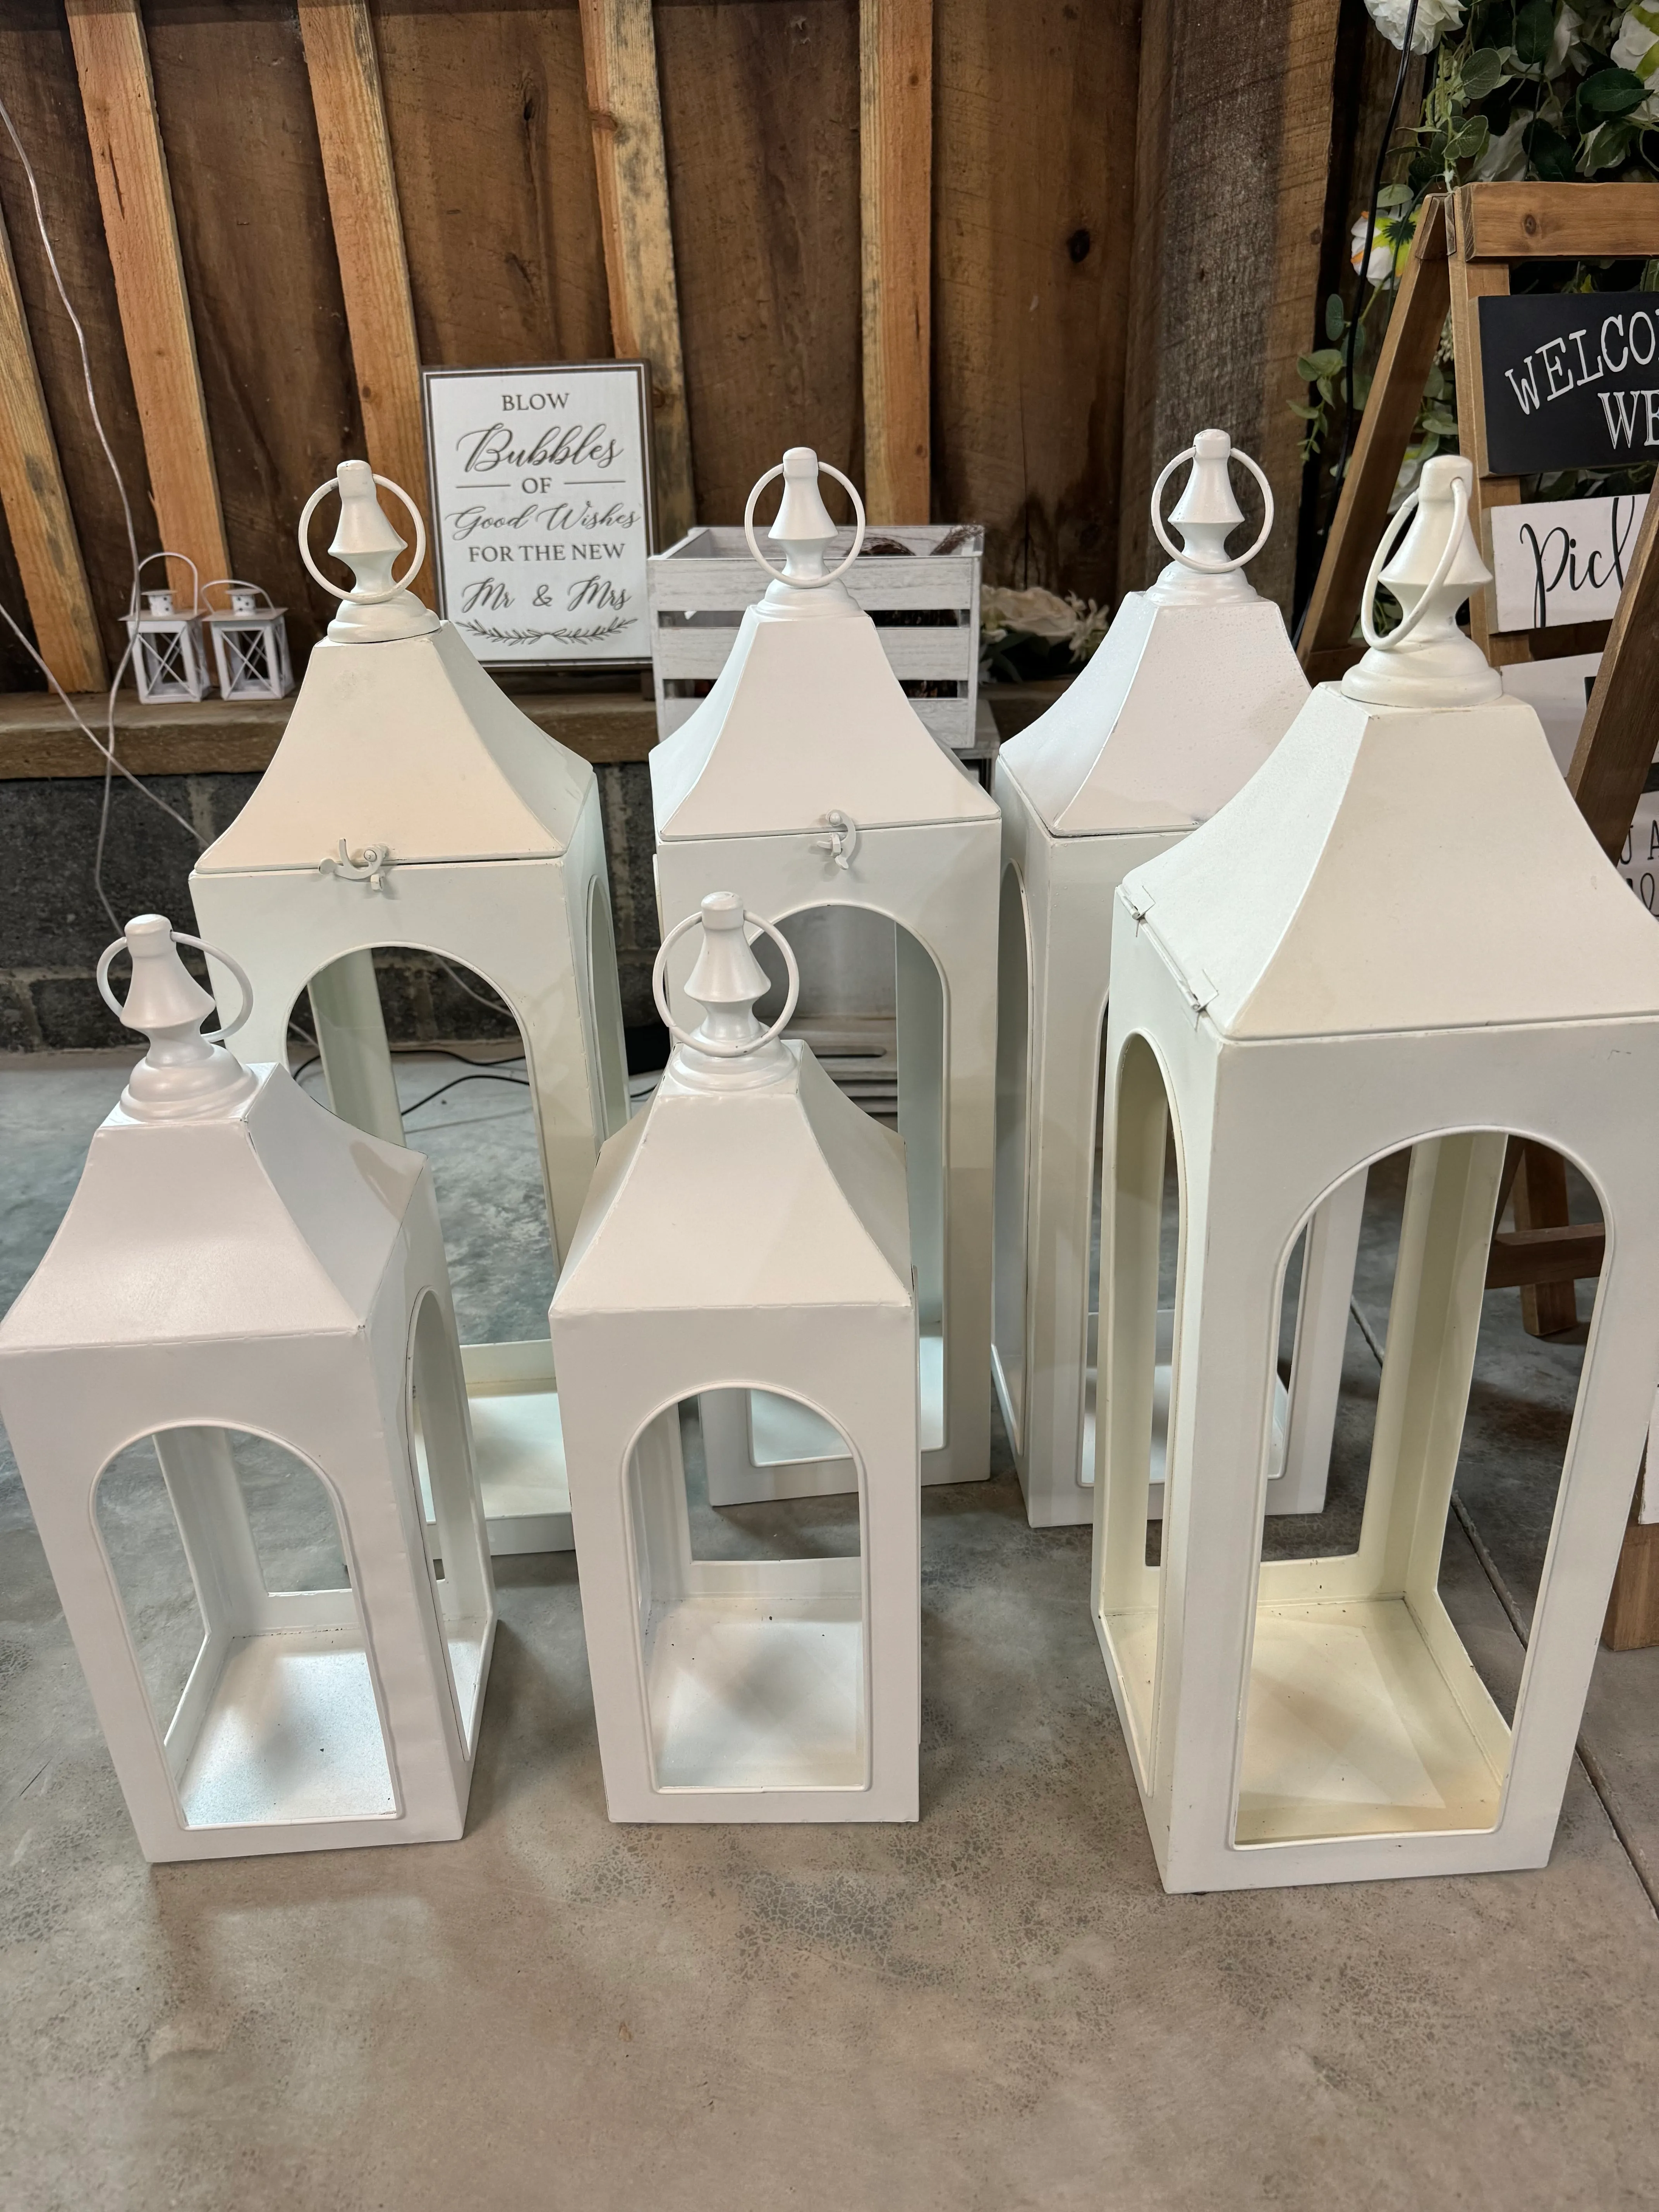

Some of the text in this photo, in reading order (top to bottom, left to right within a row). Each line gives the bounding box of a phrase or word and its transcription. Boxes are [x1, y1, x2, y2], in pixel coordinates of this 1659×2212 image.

[1505, 309, 1659, 415] WELCO
[502, 393, 569, 411] BLOW
[456, 423, 624, 472] Bubbles
[522, 478, 552, 494] OF
[445, 501, 641, 541] Good Wishes
[469, 543, 625, 562] FOR THE NEW
[462, 575, 632, 613] Mr & Mrs
